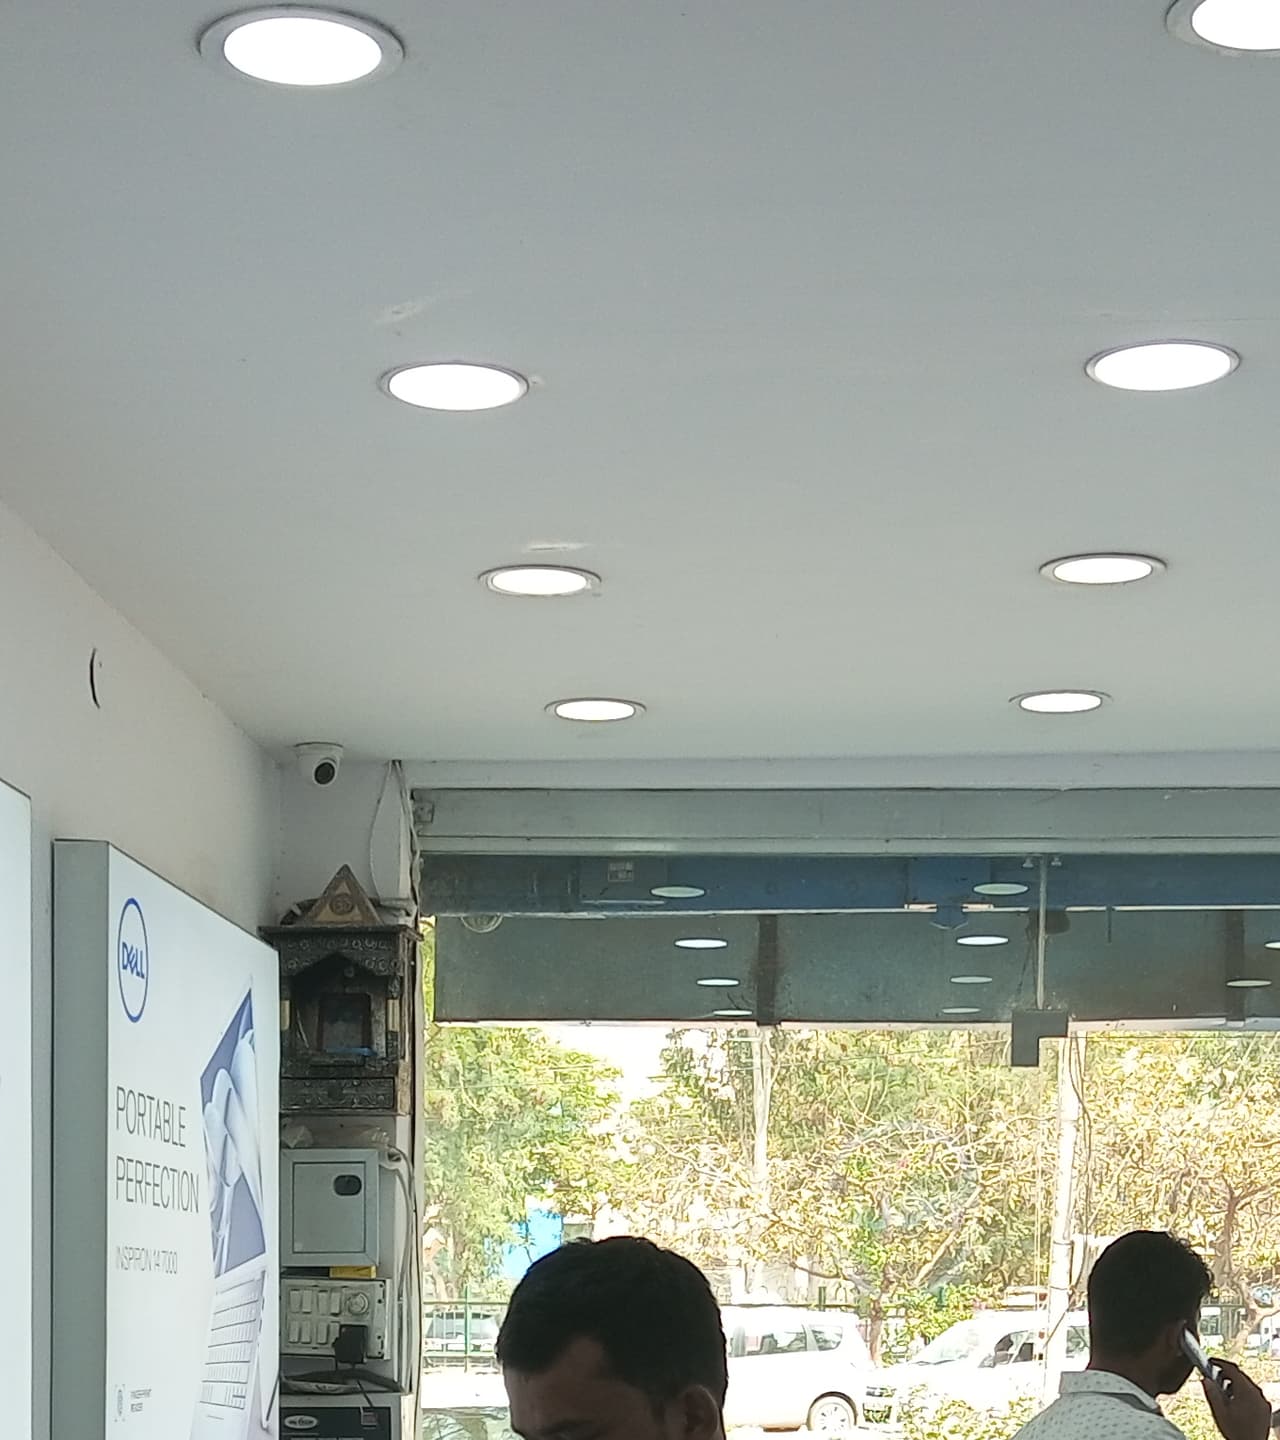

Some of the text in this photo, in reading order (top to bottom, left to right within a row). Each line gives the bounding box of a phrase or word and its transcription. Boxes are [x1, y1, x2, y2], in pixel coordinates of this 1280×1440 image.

[122, 941, 145, 980] DELL
[116, 1085, 187, 1148] PORTABLE
[116, 1155, 200, 1214] PERFECTION
